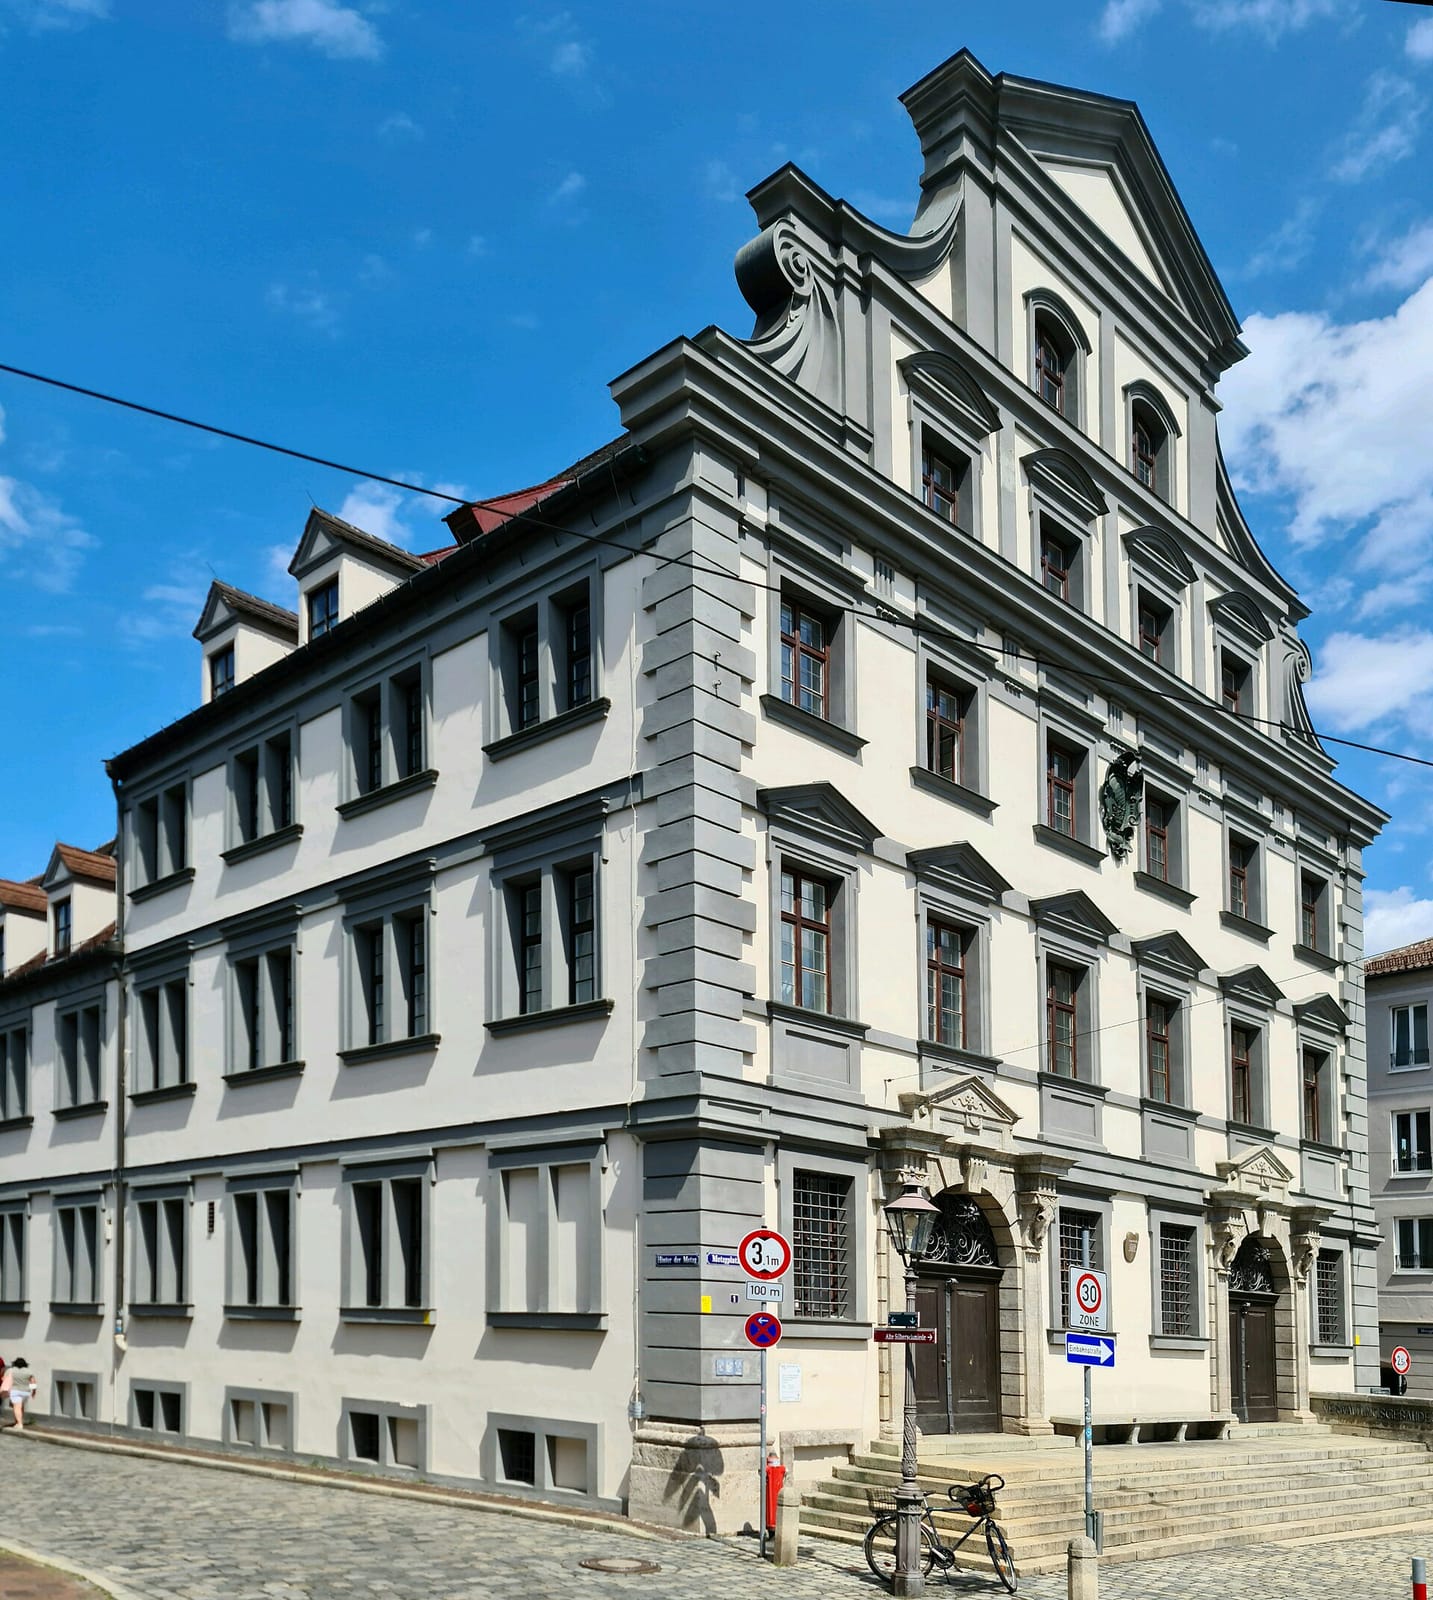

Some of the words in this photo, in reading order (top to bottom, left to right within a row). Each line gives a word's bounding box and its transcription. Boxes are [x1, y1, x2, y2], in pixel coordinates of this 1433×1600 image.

[673, 1255, 682, 1264] der
[750, 1285, 767, 1296] 100
[769, 1289, 780, 1297] m
[1082, 1284, 1097, 1303] 30
[1079, 1314, 1100, 1327] ZONE
